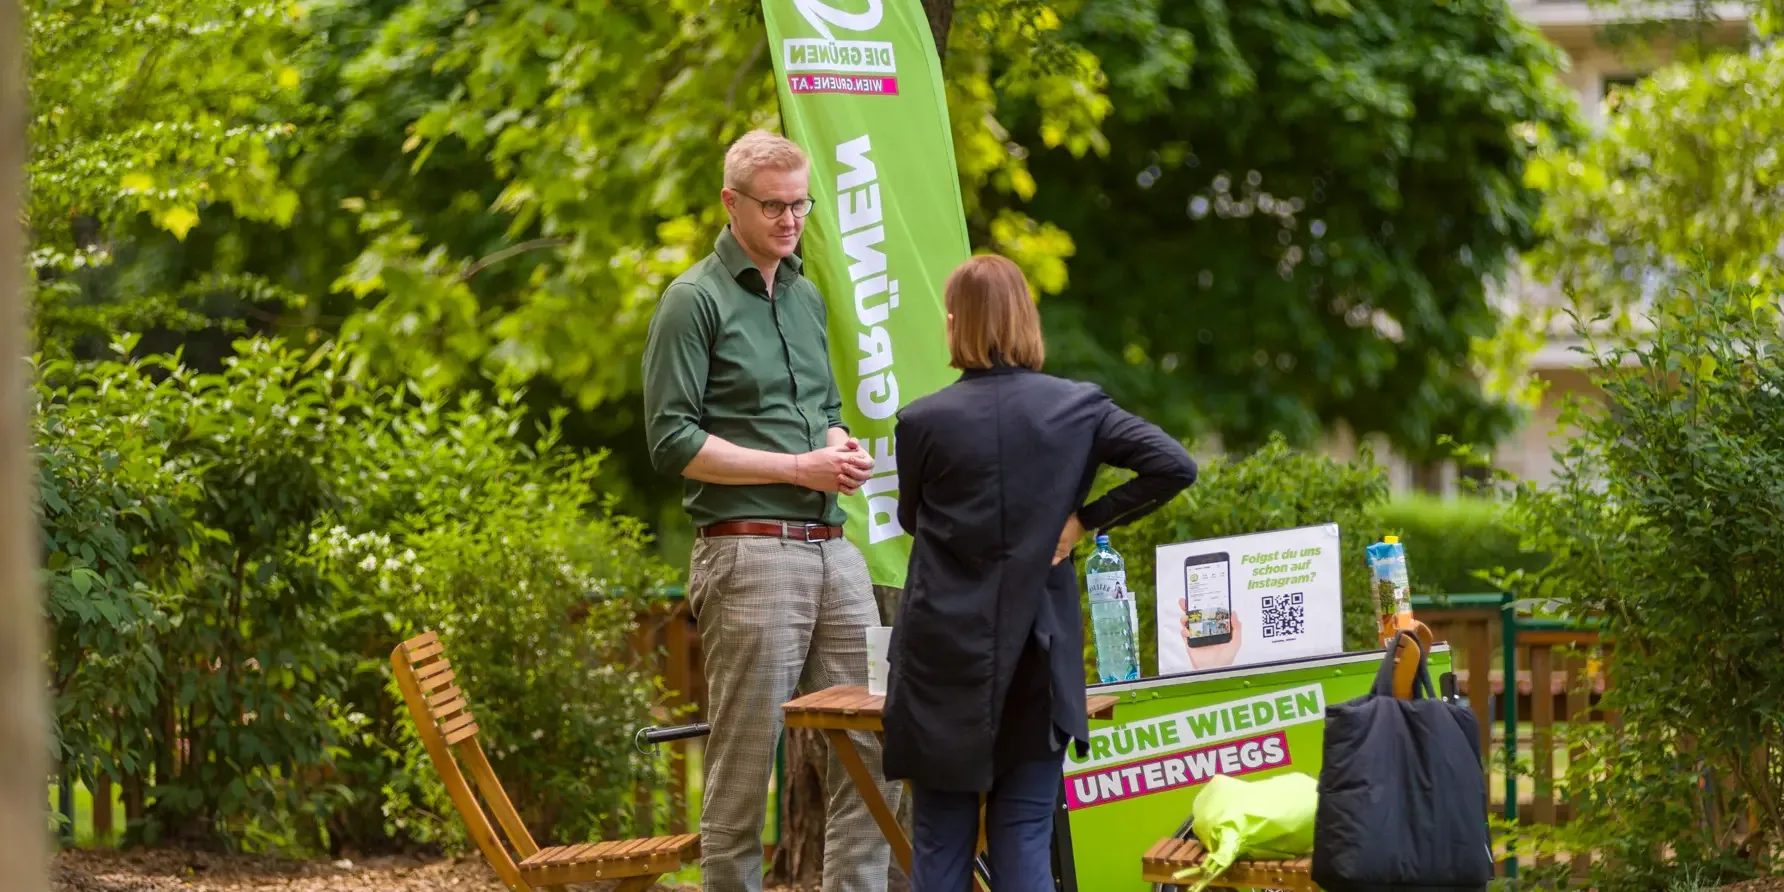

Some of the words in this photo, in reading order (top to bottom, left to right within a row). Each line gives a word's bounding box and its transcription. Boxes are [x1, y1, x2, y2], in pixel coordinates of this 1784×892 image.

[1241, 551, 1278, 565] Folgst
[1281, 549, 1297, 559] du
[1300, 547, 1321, 557] uns
[1252, 564, 1288, 577] schon
[1291, 559, 1312, 570] auf
[1247, 571, 1317, 590] Instagram?
[1187, 690, 1319, 739] WIEDEN
[1074, 737, 1285, 804] UNTERWEGS
